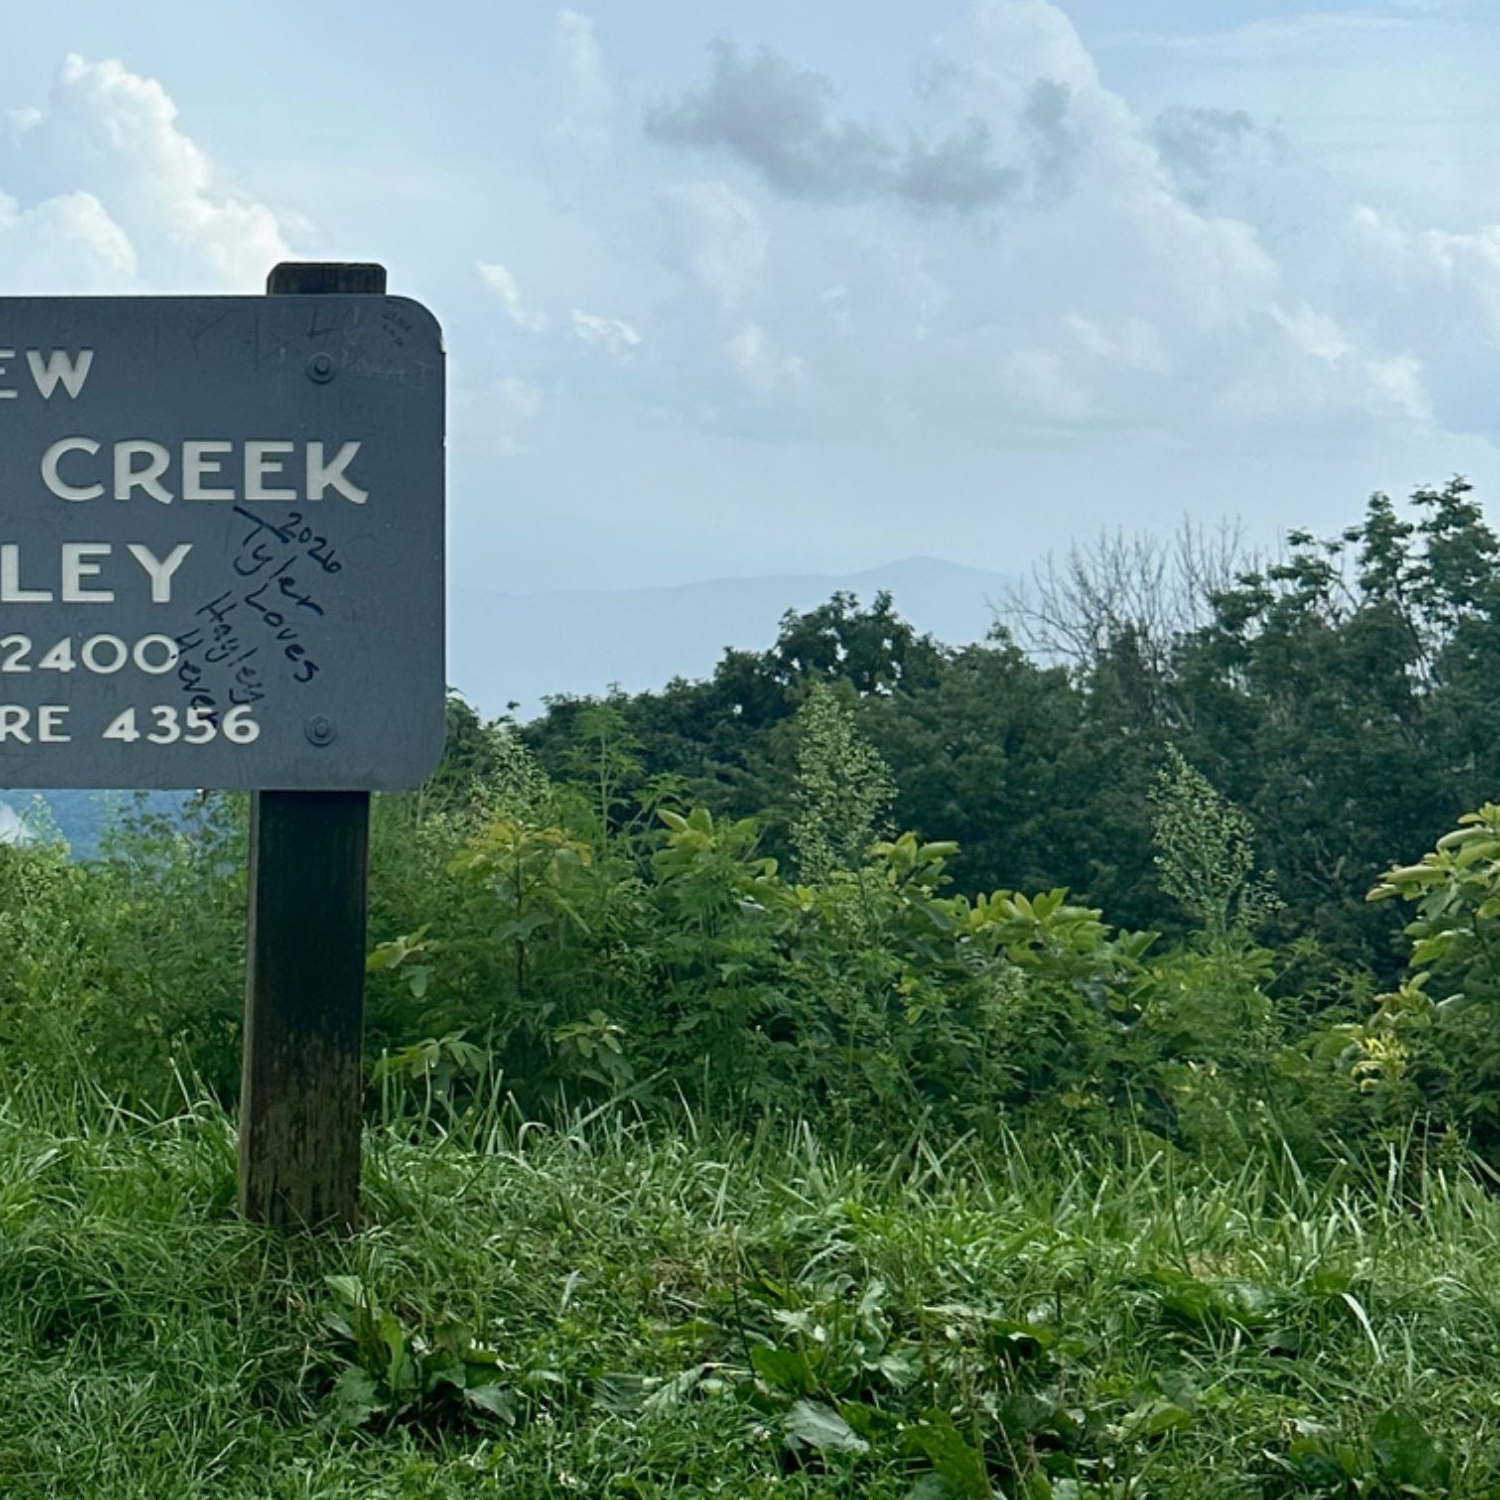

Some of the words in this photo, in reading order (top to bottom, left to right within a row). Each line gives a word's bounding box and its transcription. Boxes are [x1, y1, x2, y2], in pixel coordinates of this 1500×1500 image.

[40, 436, 369, 505] CREEK
[233, 505, 323, 616] Tyler
[278, 512, 342, 574] 2026
[0, 634, 181, 674] 2400
[195, 590, 265, 705] Hayley
[243, 583, 320, 683] Loves
[100, 704, 261, 745] 4356
